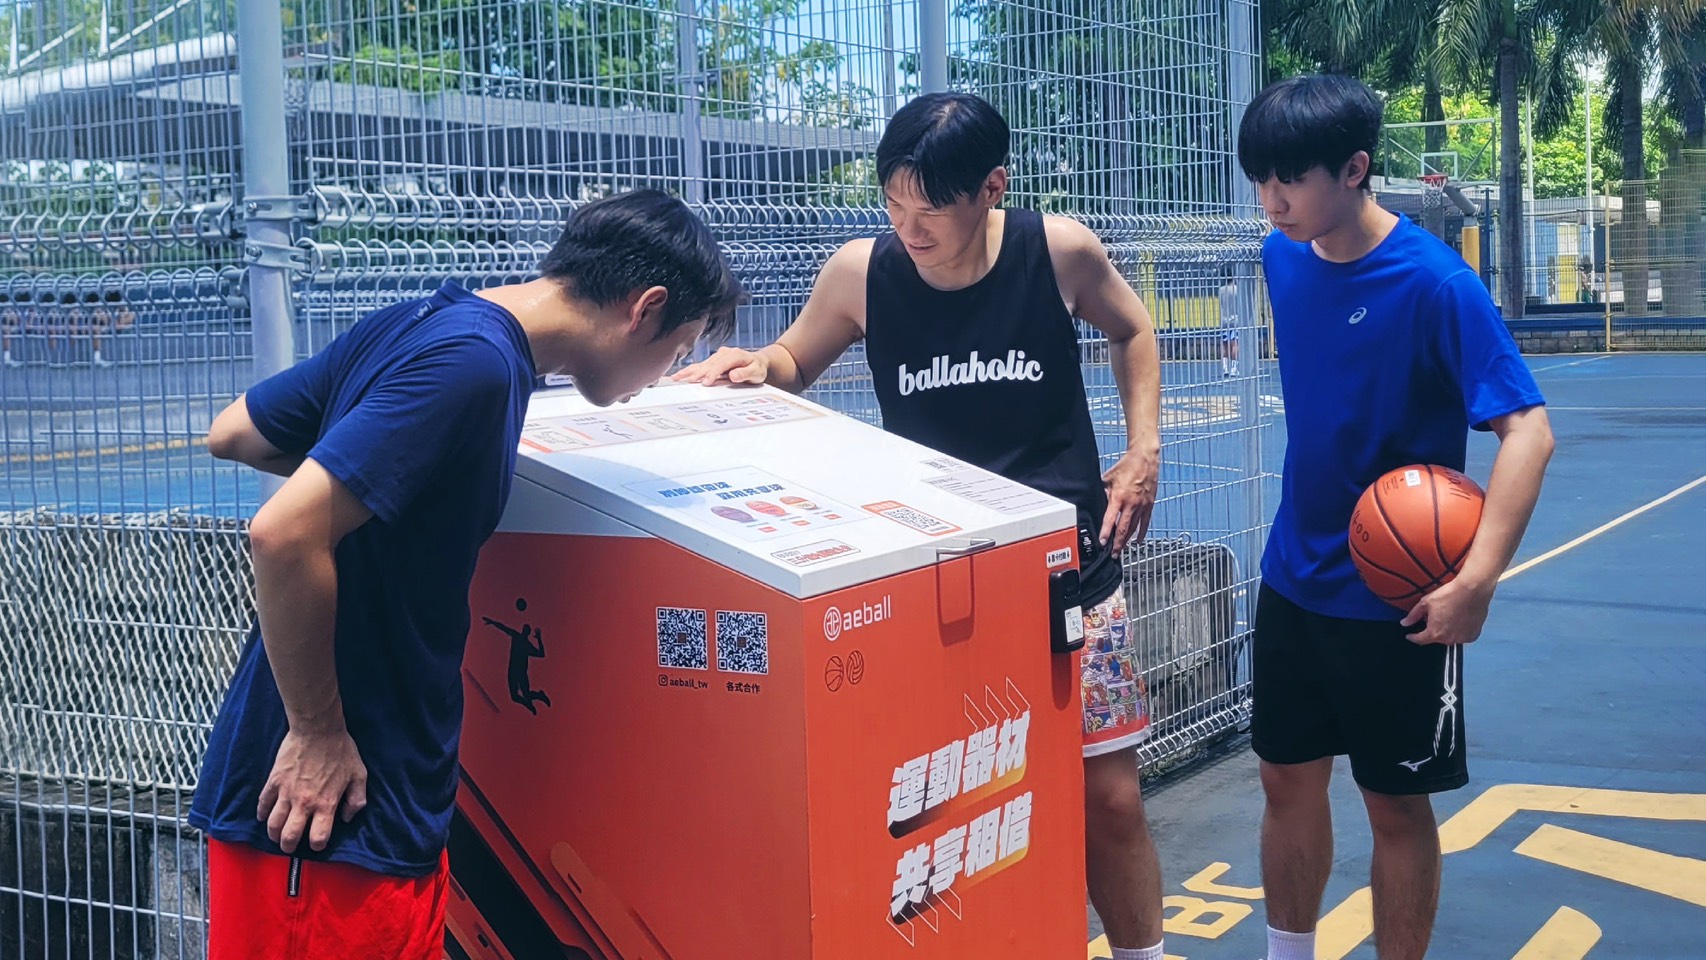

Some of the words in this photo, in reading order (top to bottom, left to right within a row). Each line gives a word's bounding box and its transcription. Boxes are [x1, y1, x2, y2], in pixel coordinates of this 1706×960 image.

[899, 350, 1044, 396] ballaholic
[843, 594, 892, 631] aeball
[669, 678, 708, 690] aeball_tw
[726, 681, 761, 694] 各式合作
[886, 709, 1031, 830] 運動器材
[889, 791, 1033, 918] 共享租借
